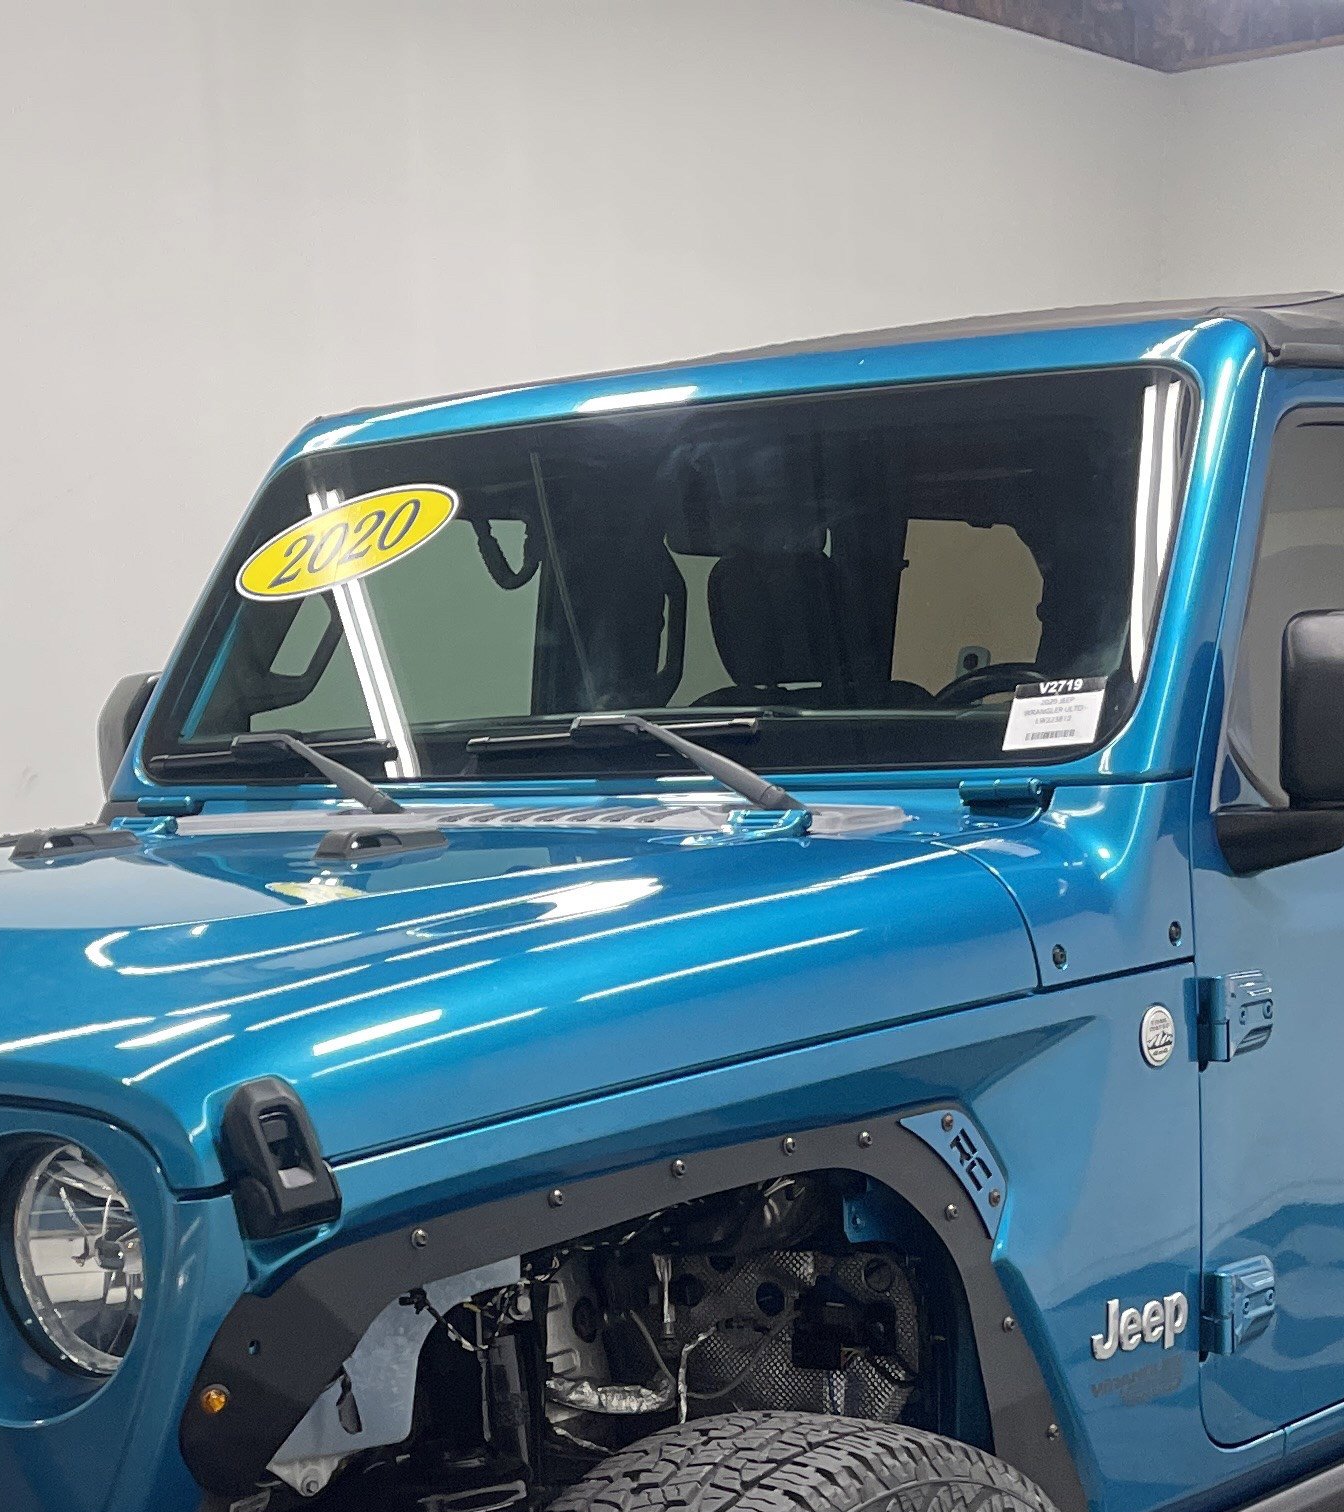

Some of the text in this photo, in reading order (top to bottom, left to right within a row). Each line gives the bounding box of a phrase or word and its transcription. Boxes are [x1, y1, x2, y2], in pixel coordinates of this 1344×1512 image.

[267, 498, 422, 590] 2020
[1039, 678, 1084, 695] V2719
[1091, 1291, 1188, 1360] Jeep
